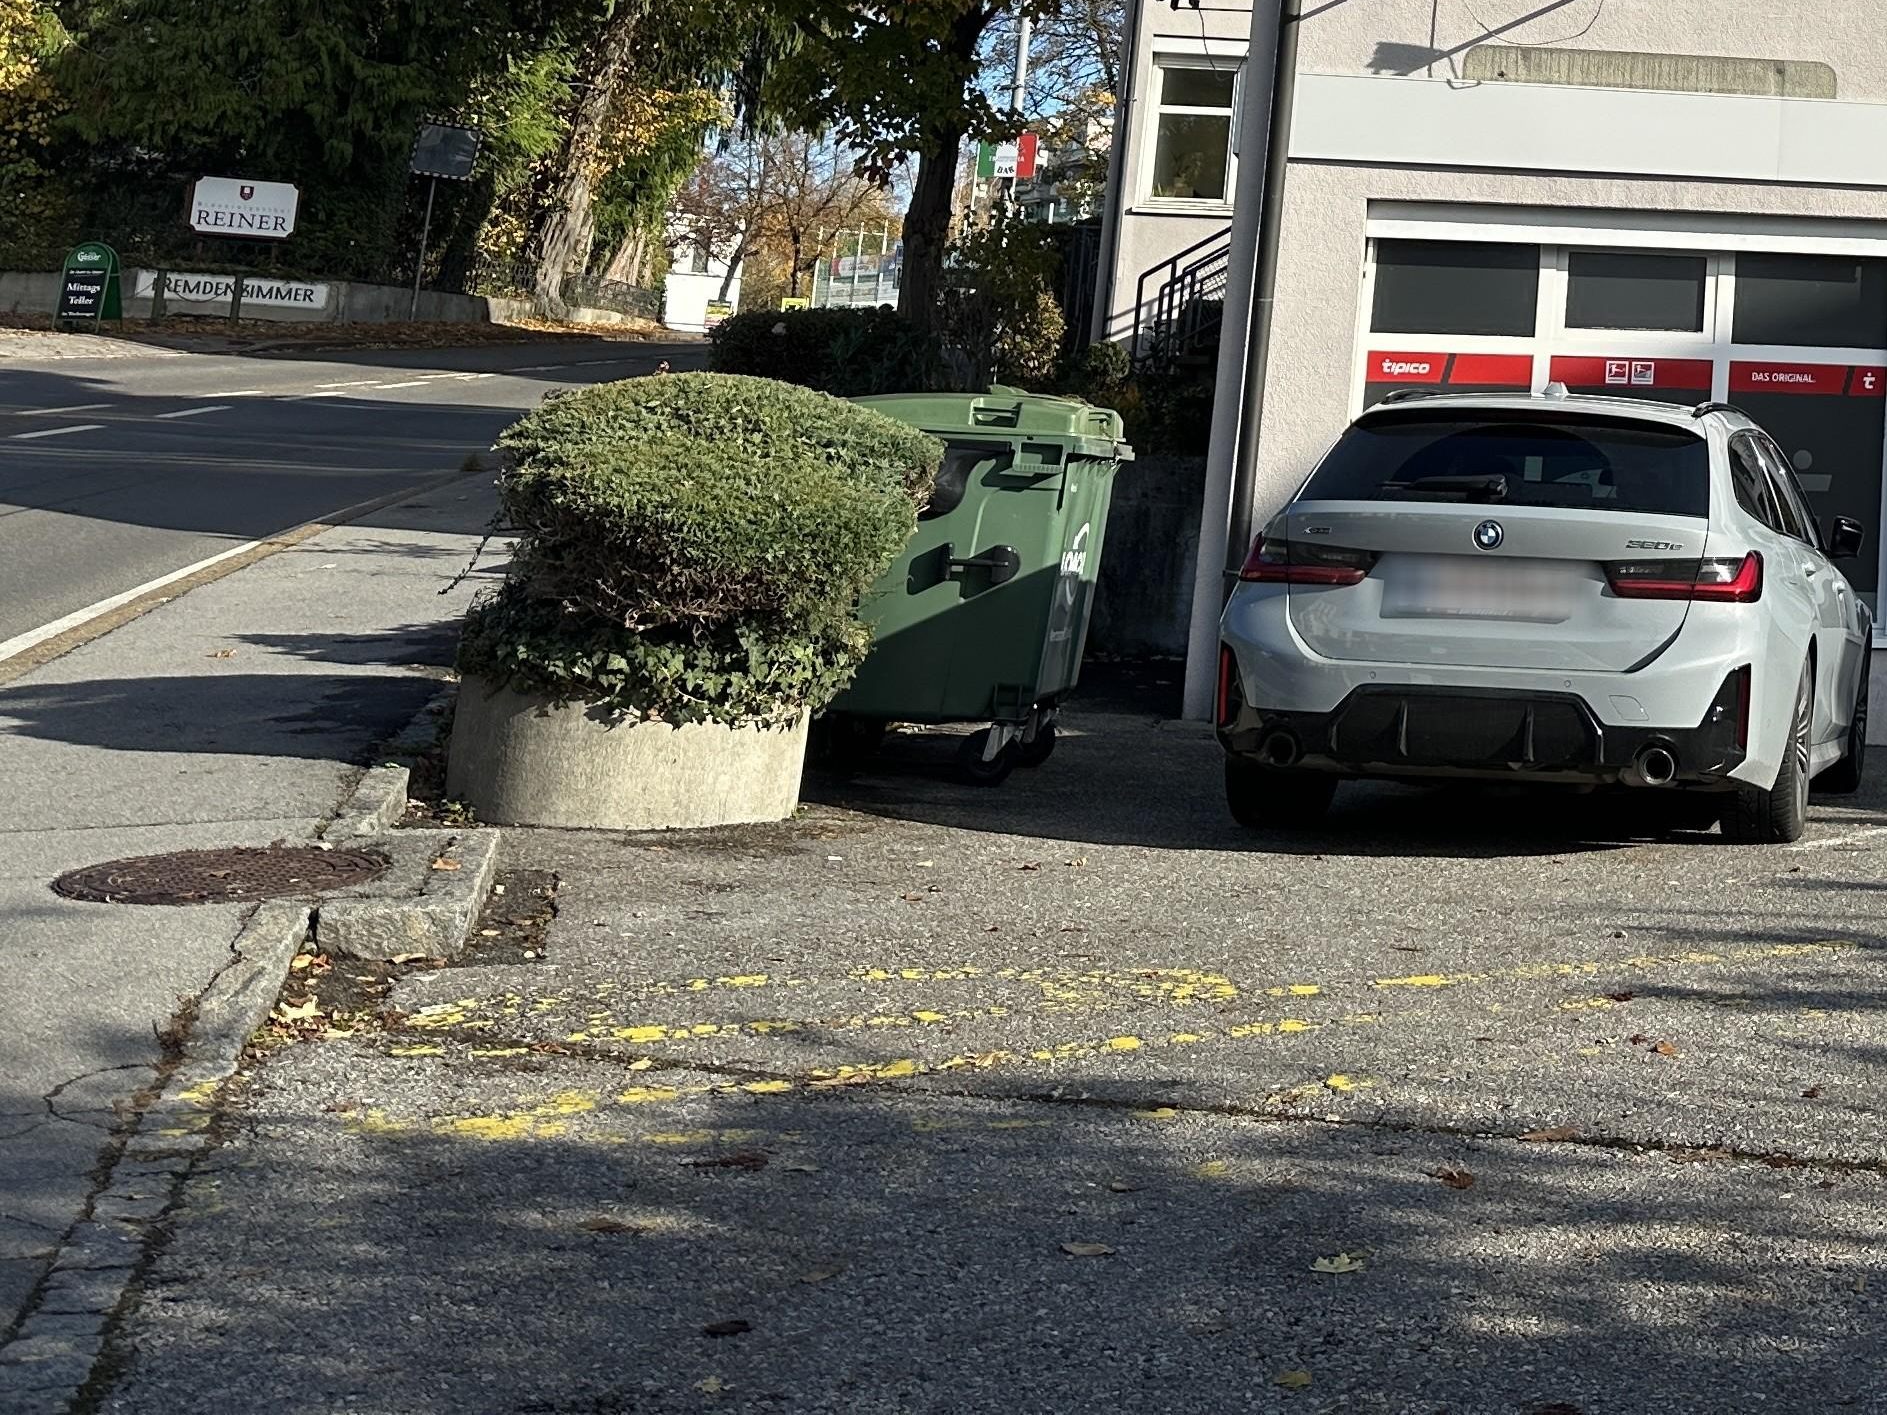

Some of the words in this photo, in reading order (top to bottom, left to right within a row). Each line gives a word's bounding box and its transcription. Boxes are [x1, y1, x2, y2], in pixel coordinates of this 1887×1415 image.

[196, 209, 289, 232] REINER
[1381, 358, 1431, 376] tipico
[1751, 371, 1770, 382] DAS
